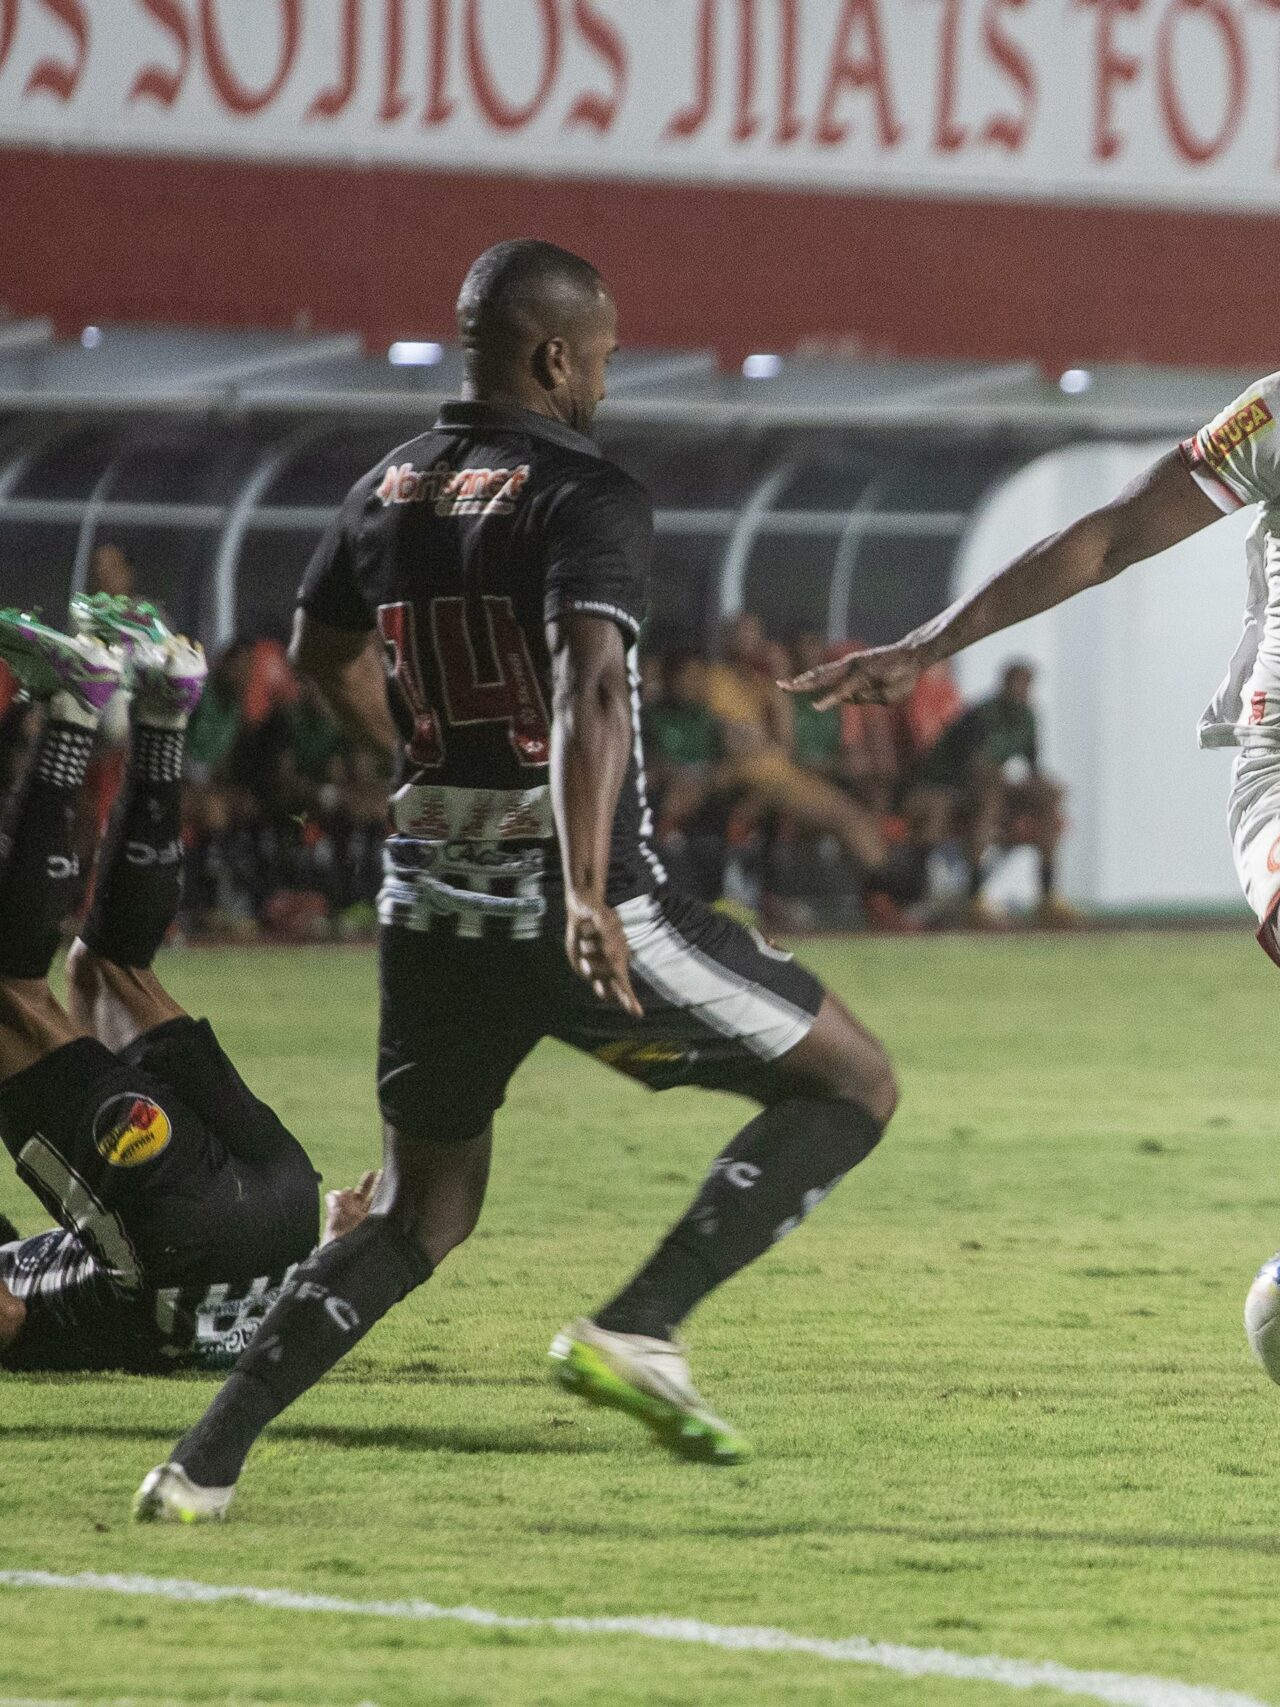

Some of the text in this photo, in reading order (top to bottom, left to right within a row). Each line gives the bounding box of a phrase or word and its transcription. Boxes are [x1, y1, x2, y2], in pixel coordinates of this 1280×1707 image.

[0, 0, 91, 106] S
[122, 0, 630, 138] SOMOS
[661, 0, 1037, 156] MAIS
[376, 596, 549, 767] 14
